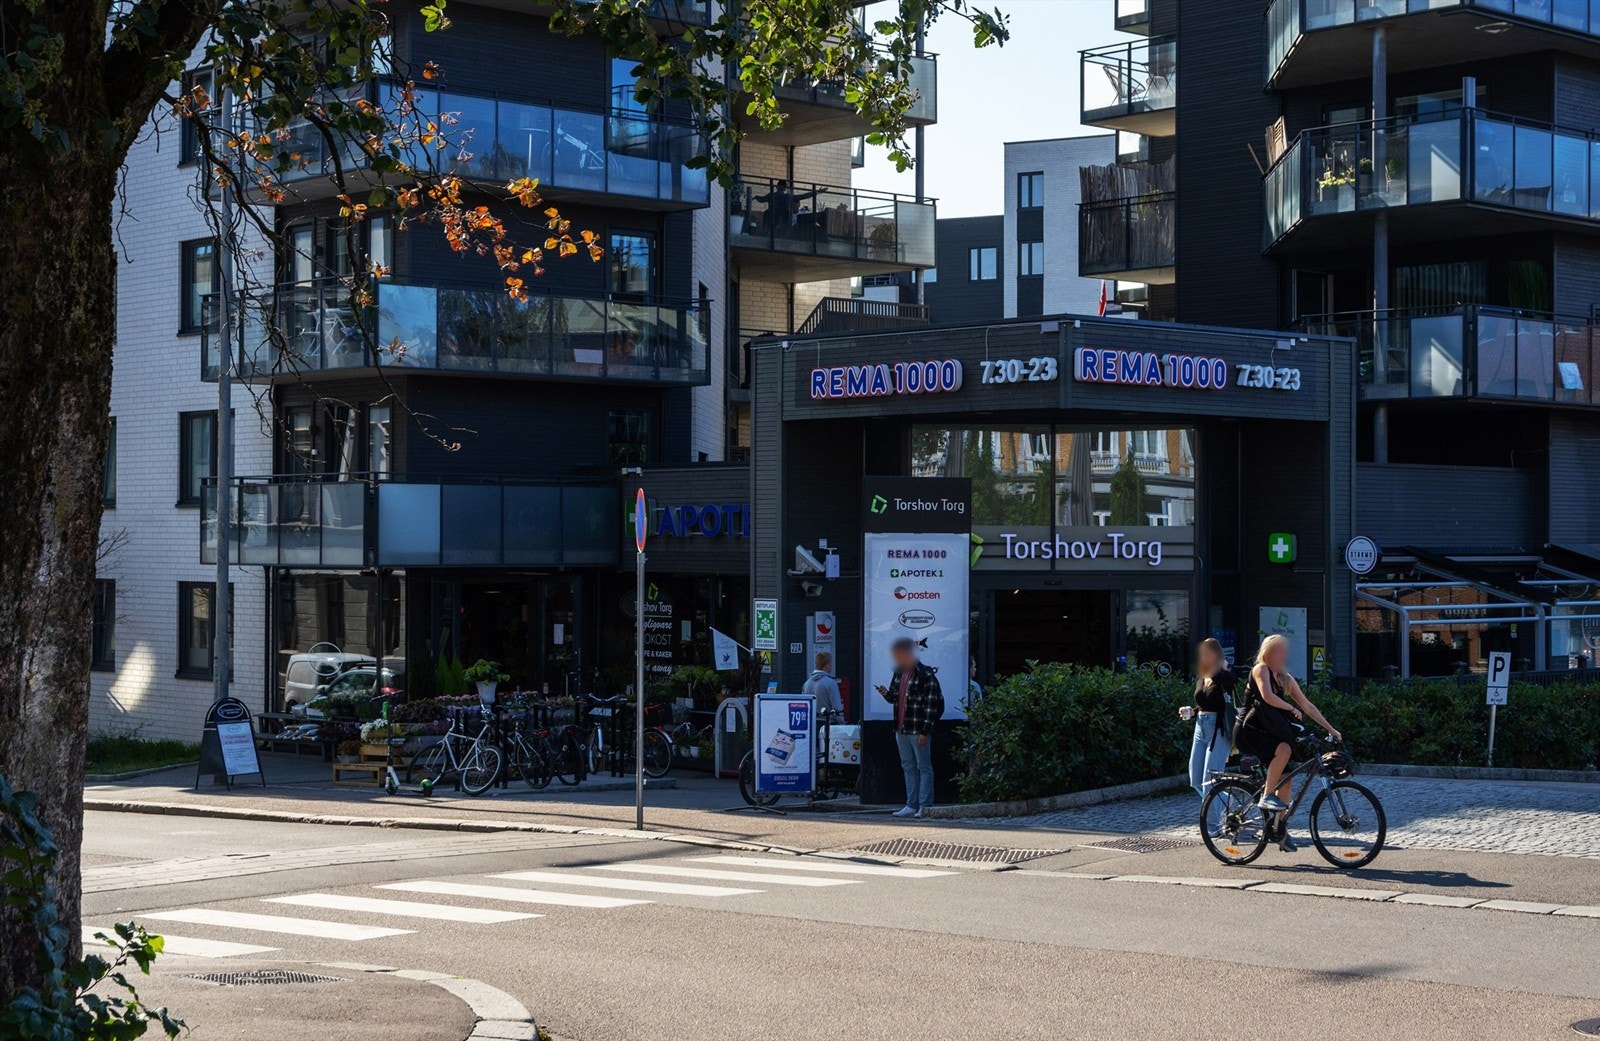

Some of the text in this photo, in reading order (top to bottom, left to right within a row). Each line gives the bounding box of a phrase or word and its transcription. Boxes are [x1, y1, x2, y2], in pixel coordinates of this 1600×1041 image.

[979, 356, 1058, 385] 7.30-23
[1074, 347, 1228, 391] REMA 1000
[1236, 362, 1302, 391] 7.30-23
[809, 358, 964, 400] REMA 1000
[894, 497, 965, 514] Torshov Torg
[887, 549, 947, 559] REMA 1000
[999, 532, 1163, 567] Torshov Torg
[900, 569, 944, 578] APOTEK 1
[907, 590, 941, 601] posten
[658, 601, 673, 616] Torg
[791, 643, 802, 653] 22A
[1492, 656, 1506, 682] P
[790, 711, 801, 726] 79
